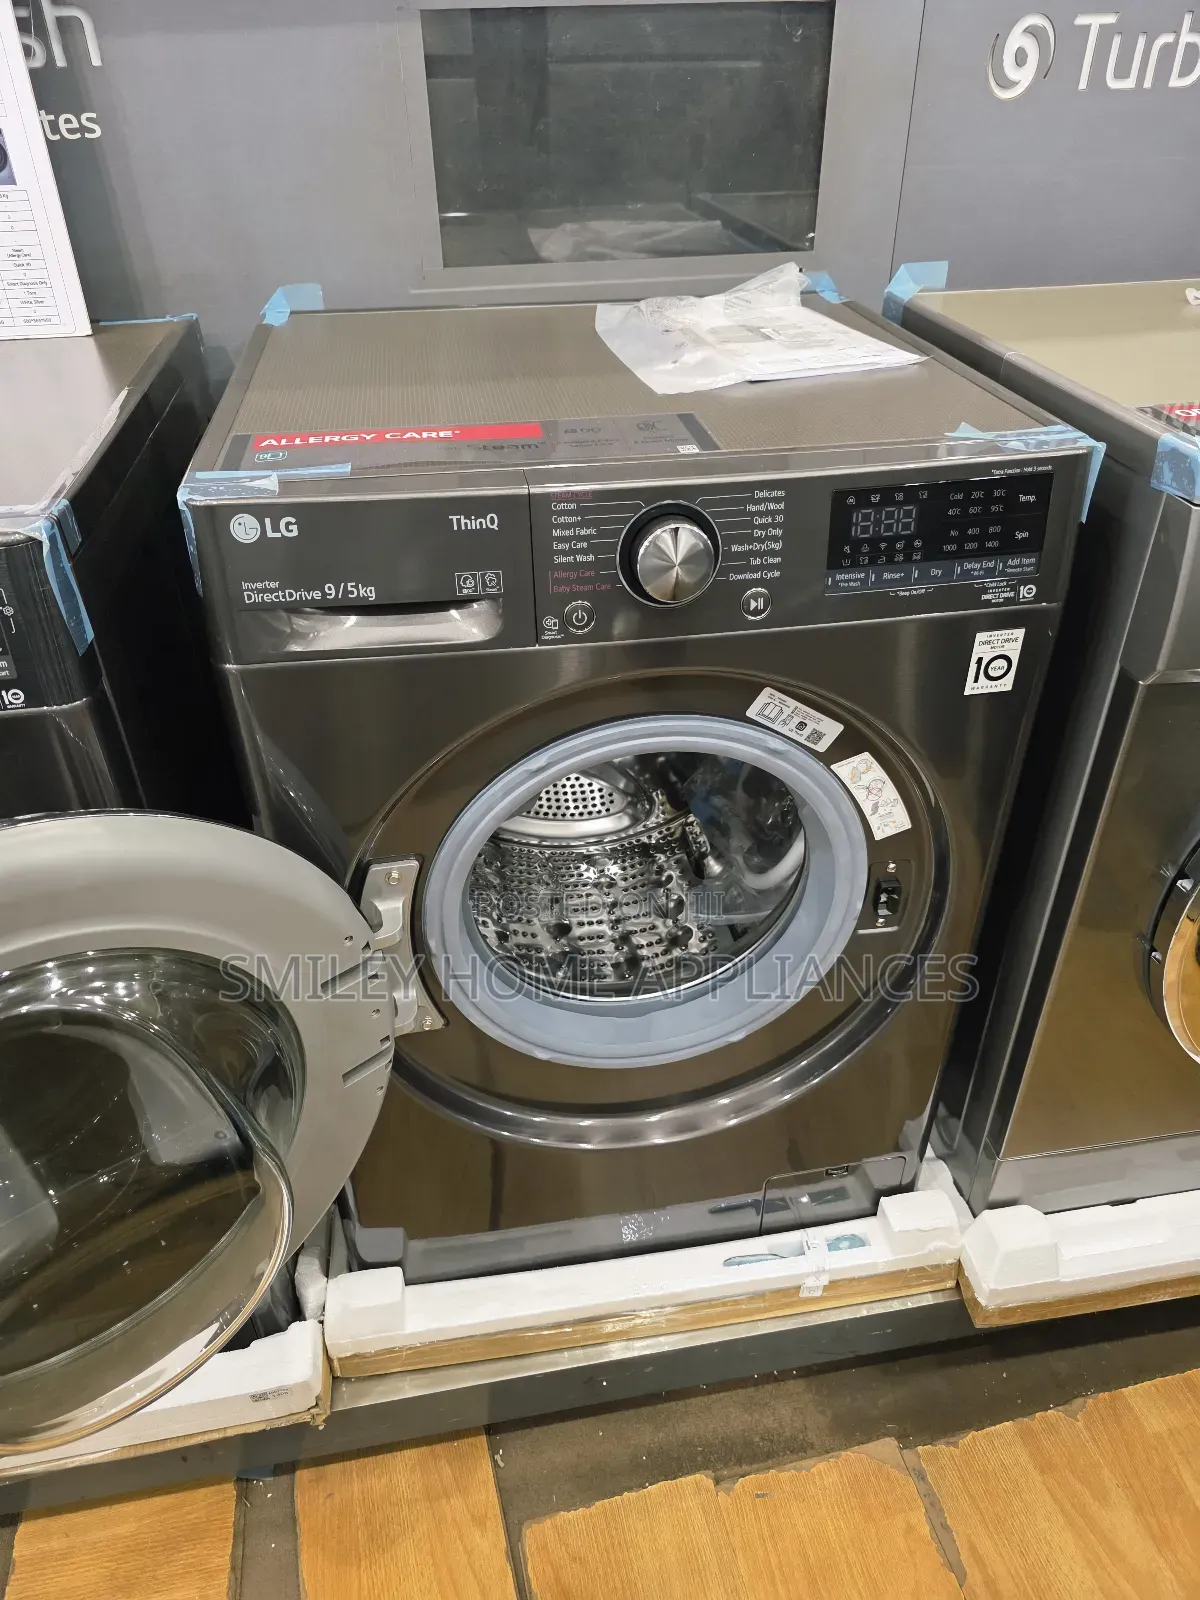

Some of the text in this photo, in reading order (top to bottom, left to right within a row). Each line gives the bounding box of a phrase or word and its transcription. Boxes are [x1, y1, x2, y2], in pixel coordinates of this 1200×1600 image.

[1073, 11, 1200, 91] Turb
[39, 109, 102, 140] tes
[258, 433, 379, 447] ALLERGY
[754, 489, 786, 499] Delicates
[949, 492, 964, 501] Cold
[1018, 494, 1037, 503] Temp.
[551, 502, 577, 511] Cotton
[746, 501, 785, 512] Hand/Wool
[448, 513, 499, 532] ThinQ
[551, 515, 582, 524] Cotton+
[753, 514, 784, 525] Quick 30
[264, 517, 299, 538] LG
[552, 527, 597, 537] Mixed Fabric
[753, 527, 783, 538] Dry Only
[949, 525, 1001, 537] No 400 800
[1014, 530, 1029, 540] Spin
[553, 541, 588, 551] Easy Care
[731, 540, 783, 552] Wash+Dry(5kg)
[942, 540, 999, 552] 1000 1200 1400
[553, 554, 595, 564] Silent Wash
[749, 555, 782, 566] Tub Clean
[1006, 557, 1036, 566] Add Item
[963, 560, 995, 570] Delay End
[553, 570, 578, 579] Allergy
[729, 569, 781, 581] Download Cycle
[835, 571, 866, 581] Intensive
[882, 571, 905, 580] Rinse+
[930, 568, 943, 577] Dry
[241, 580, 280, 590] Inverter
[553, 583, 612, 594] Baby Steam Care
[1019, 584, 1037, 599] 10
[986, 631, 1014, 639] INVERTER
[978, 636, 1020, 647] DIRECT DRIVE
[973, 653, 1013, 684] 10
